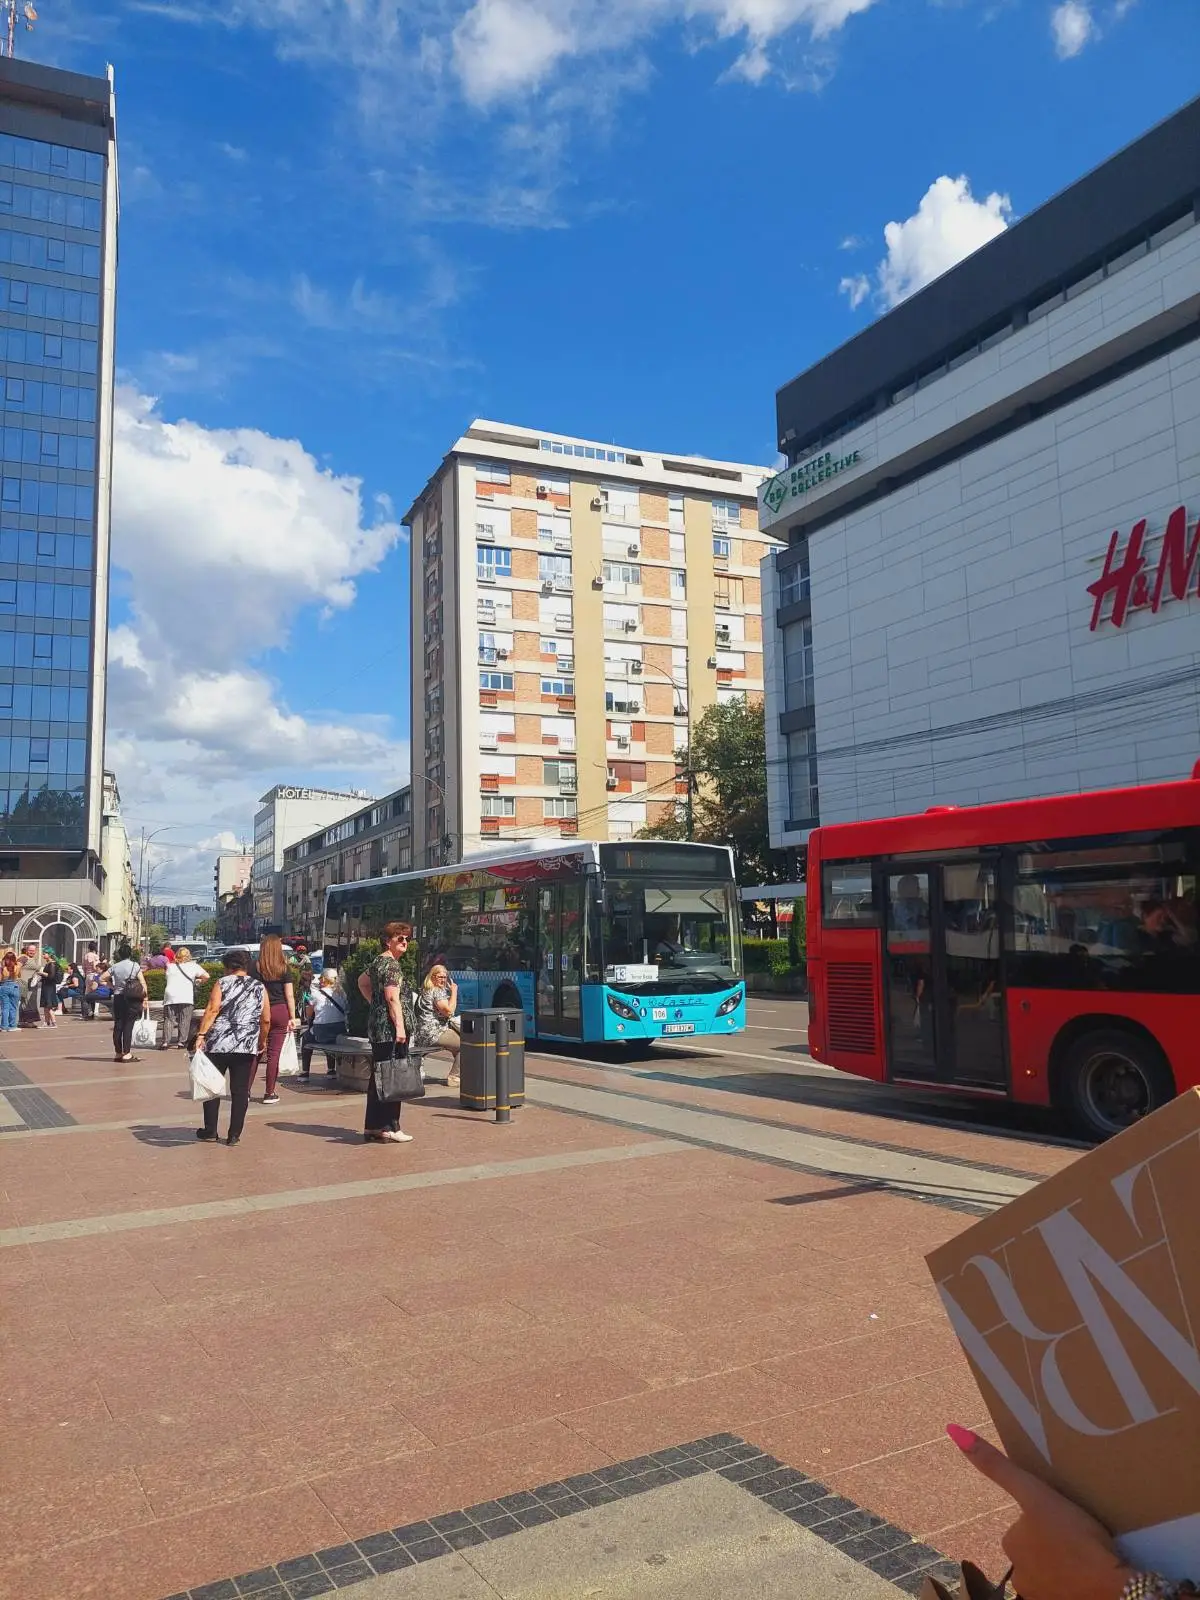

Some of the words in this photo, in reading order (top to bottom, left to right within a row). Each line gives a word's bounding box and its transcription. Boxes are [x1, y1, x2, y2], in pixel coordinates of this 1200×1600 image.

[790, 452, 832, 483] BETTER
[791, 450, 861, 497] COLLECTIVE
[1086, 505, 1200, 632] H&M
[278, 788, 312, 799] HOTEL
[654, 1009, 666, 1019] 106
[936, 1129, 1200, 1466] ARA
